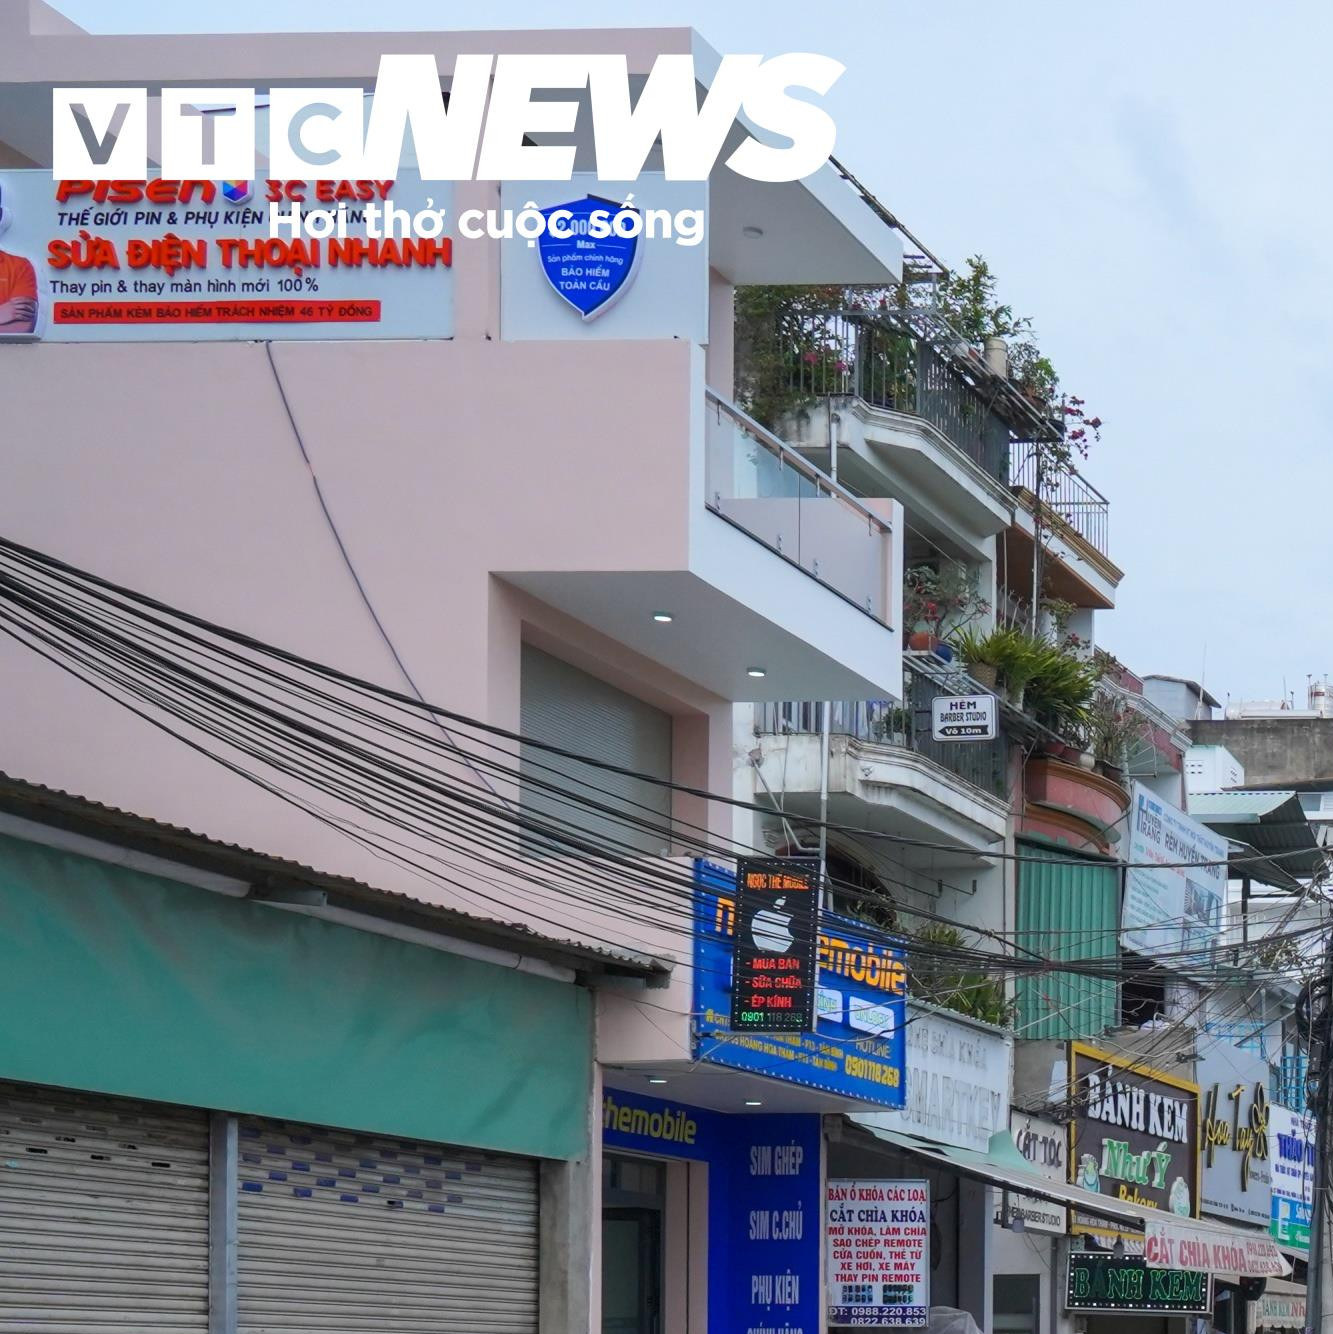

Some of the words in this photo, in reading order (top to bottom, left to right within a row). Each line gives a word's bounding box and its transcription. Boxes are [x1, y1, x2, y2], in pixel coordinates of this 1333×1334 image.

[314, 179, 396, 203] EASY
[57, 206, 92, 227] THẾ
[93, 208, 128, 226] GIỚI
[134, 211, 162, 226] PIN
[166, 211, 178, 225] &
[184, 211, 219, 229] PHỤ
[223, 206, 264, 228] KIỆN
[47, 229, 120, 270] SỬA
[126, 232, 208, 276] ĐIỆN
[216, 236, 321, 276] THOẠI
[328, 236, 453, 268] NHANH
[50, 280, 87, 295] Thay
[91, 279, 113, 295] pin
[117, 281, 129, 293] &
[133, 280, 166, 295] thay
[170, 279, 203, 293] màn
[207, 279, 237, 293] hình
[241, 278, 271, 293] mới
[215, 304, 255, 318] TRÁCH
[752, 958, 777, 970] MUA
[741, 1011, 764, 1022] 0901
[1148, 1092, 1188, 1144] KEM
[750, 1146, 772, 1176] SIM
[774, 1139, 804, 1176] GHÉP
[828, 1184, 848, 1201] BÁN
[858, 1185, 885, 1202] KHÓA
[887, 1185, 906, 1201] CÁC
[907, 1187, 927, 1205] LOẠ
[829, 1203, 855, 1223] CẮT
[857, 1206, 888, 1223] CHÌA
[891, 1206, 926, 1223] KHÓA
[749, 1209, 770, 1240] SIM
[832, 1238, 852, 1248] SAO
[855, 1236, 881, 1248] CHÉP
[883, 1238, 923, 1248] REMOTE
[840, 1262, 853, 1271] XE
[878, 1262, 891, 1271] XE
[834, 1273, 859, 1283] THAY
[861, 1273, 879, 1283] PIN
[881, 1273, 921, 1283] REMOTE
[1150, 1269, 1202, 1302] KEM
[751, 1275, 773, 1311] PHỤ
[775, 1269, 800, 1311] KIỆN
